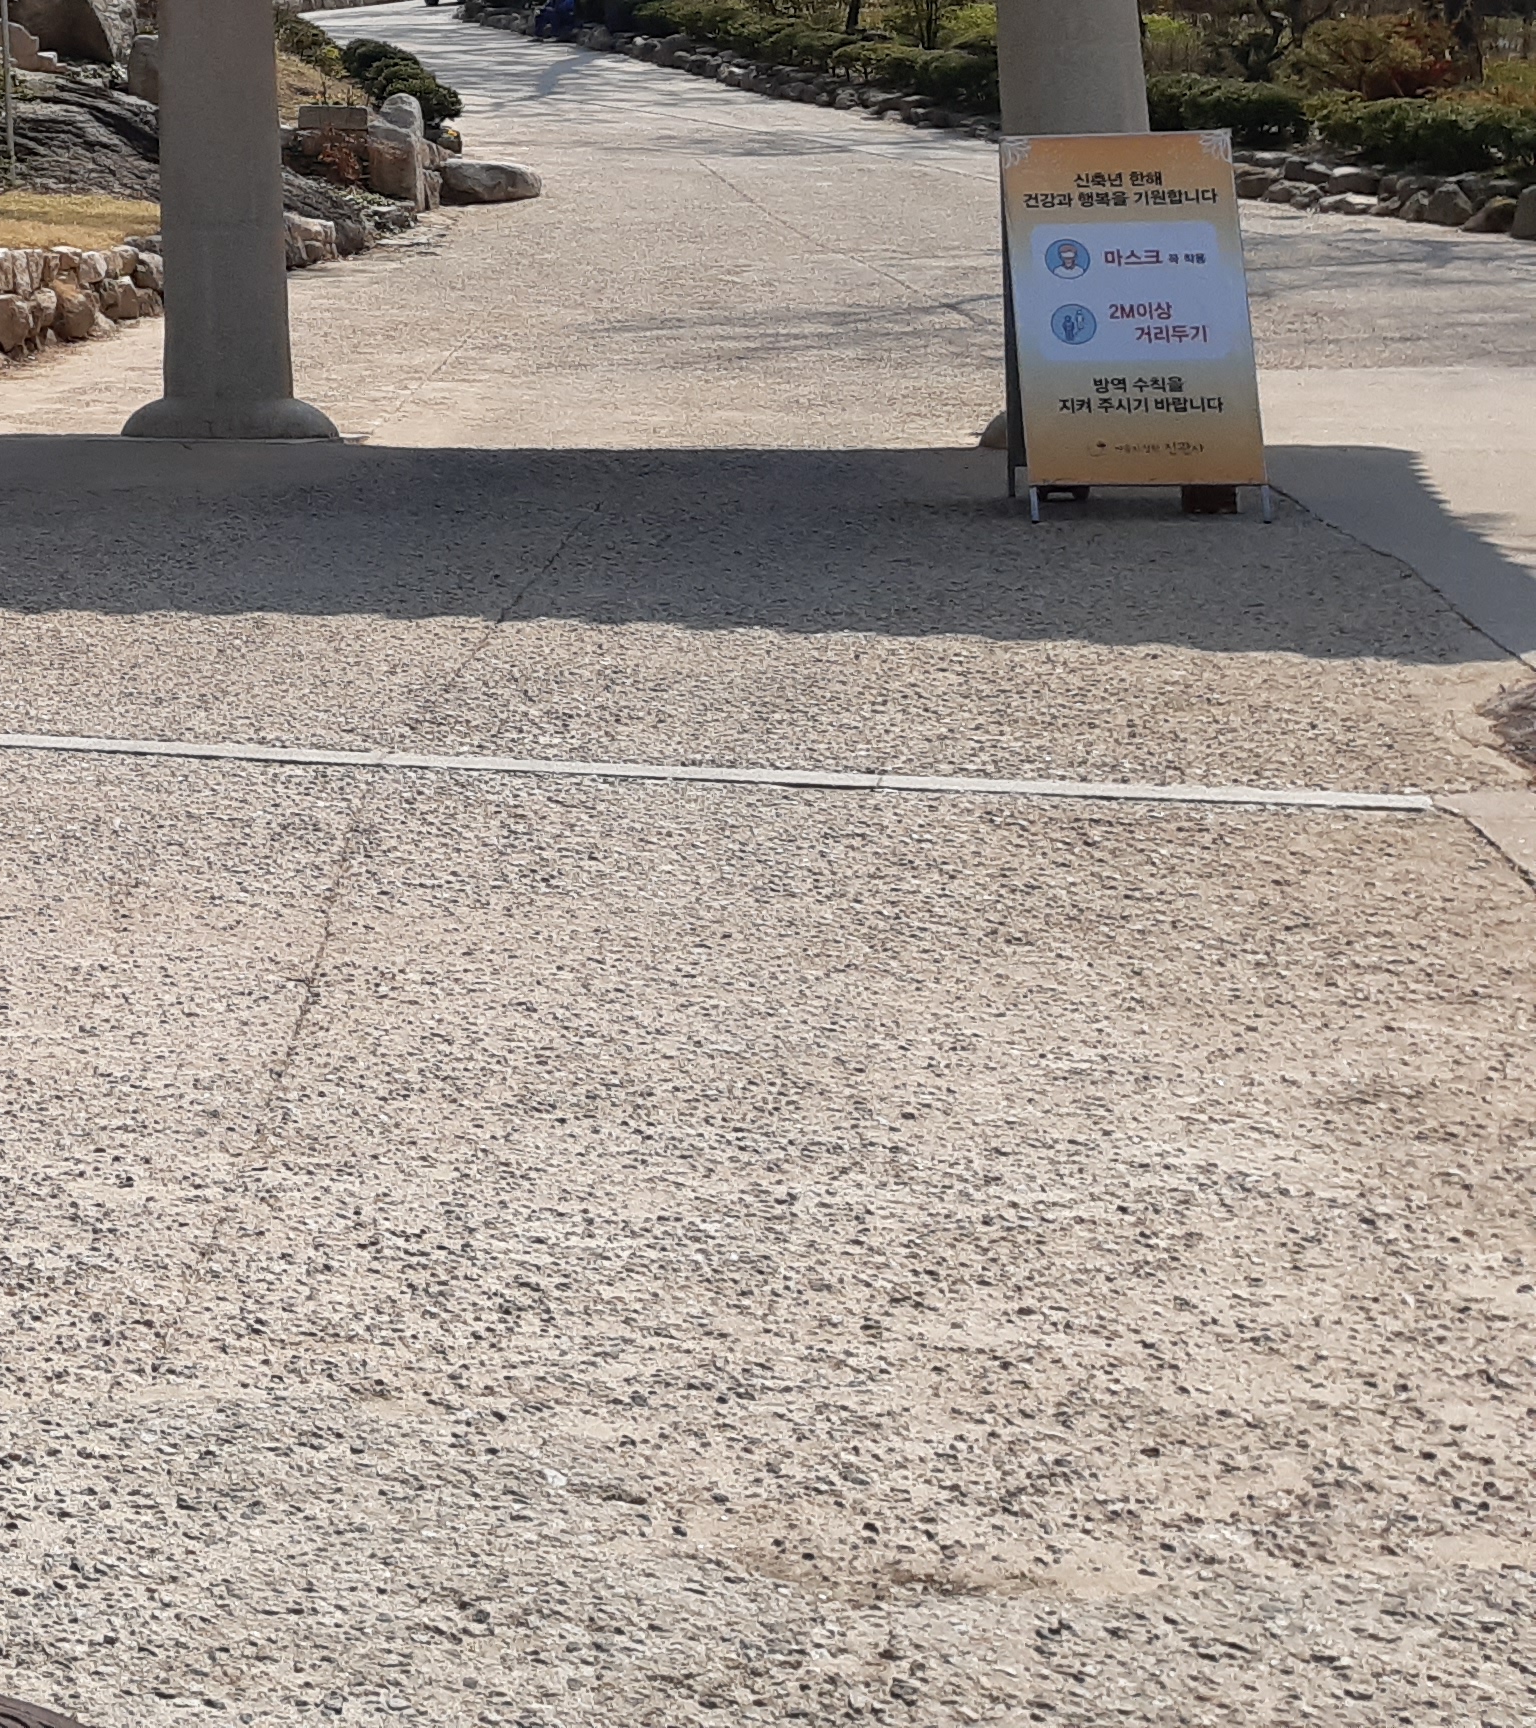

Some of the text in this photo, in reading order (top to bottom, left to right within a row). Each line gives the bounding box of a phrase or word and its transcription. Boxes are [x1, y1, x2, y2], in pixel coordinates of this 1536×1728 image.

[1023, 188, 1218, 208] 건강과 행복을 기원합니다
[1104, 248, 1163, 267] 마스크
[1109, 301, 1172, 320] 2M이상
[1134, 324, 1208, 343] 거리두기
[1093, 376, 1185, 393] 방역 수칙을
[1059, 396, 1224, 414] 지켜 주시기 바랍니다
